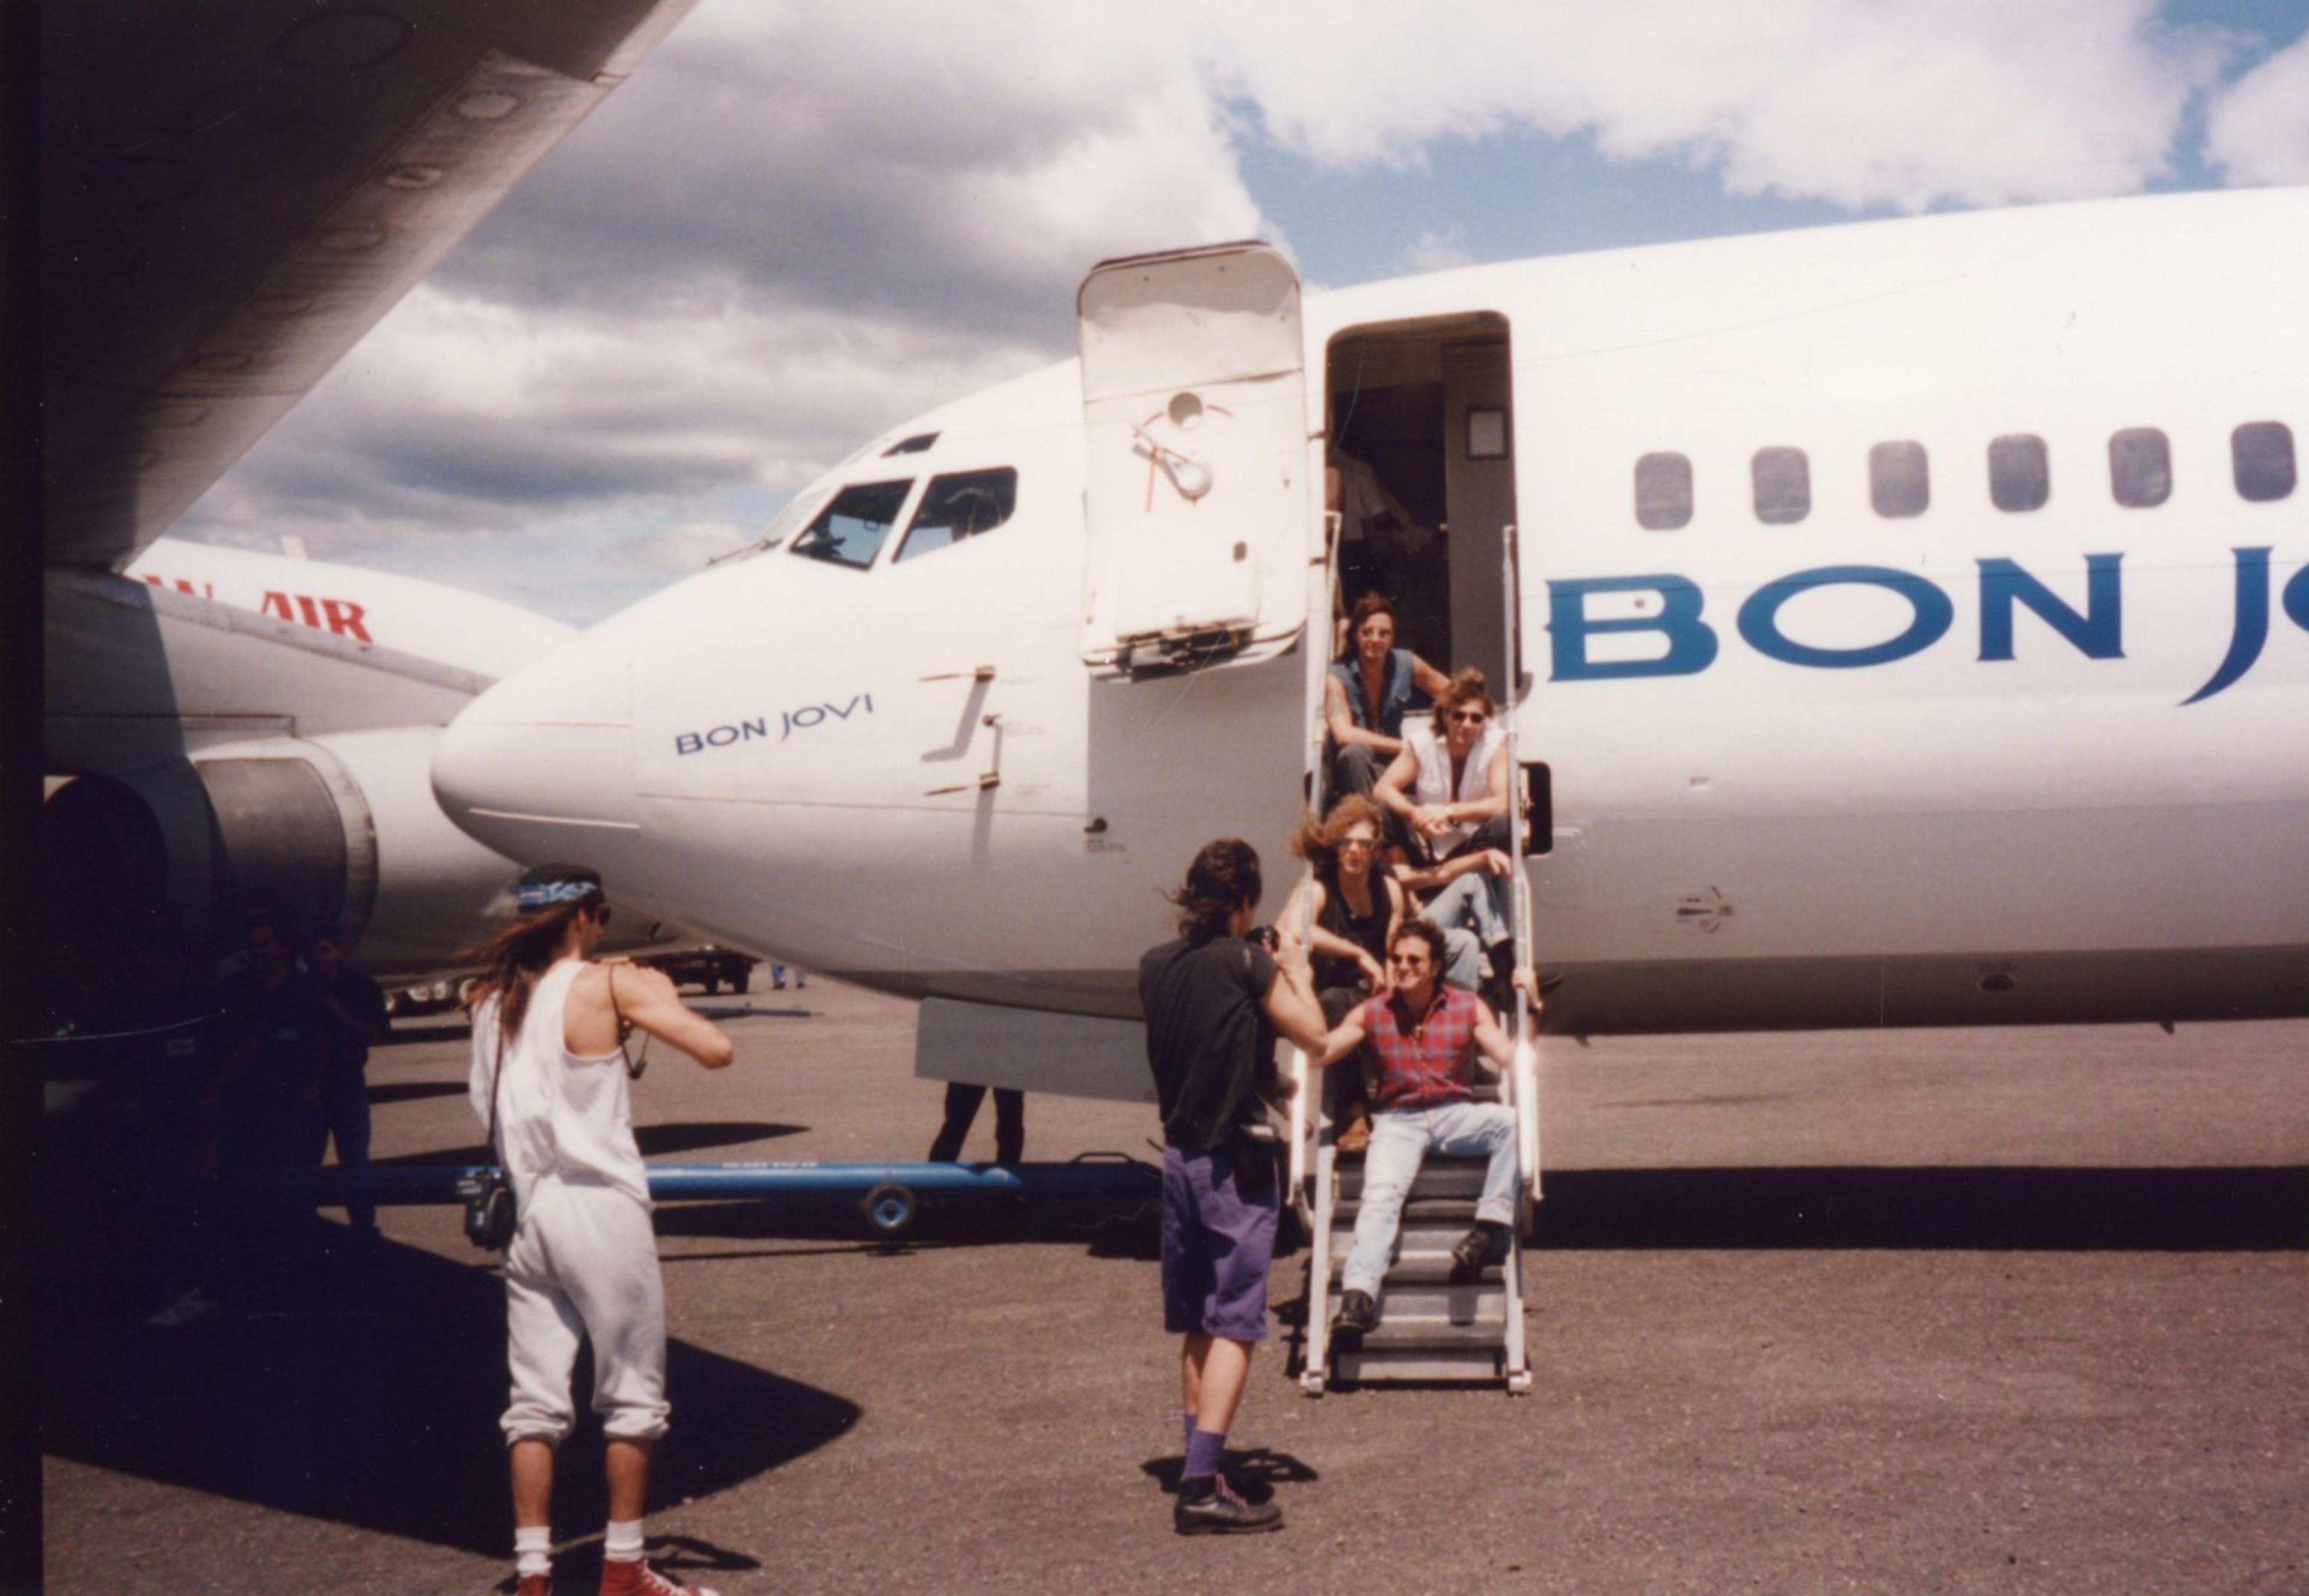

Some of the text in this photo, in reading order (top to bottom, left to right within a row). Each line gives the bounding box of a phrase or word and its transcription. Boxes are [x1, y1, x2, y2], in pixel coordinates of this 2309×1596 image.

[261, 591, 373, 643] AIR
[1545, 545, 2309, 707] BON J
[675, 693, 873, 755] BON JOVI
